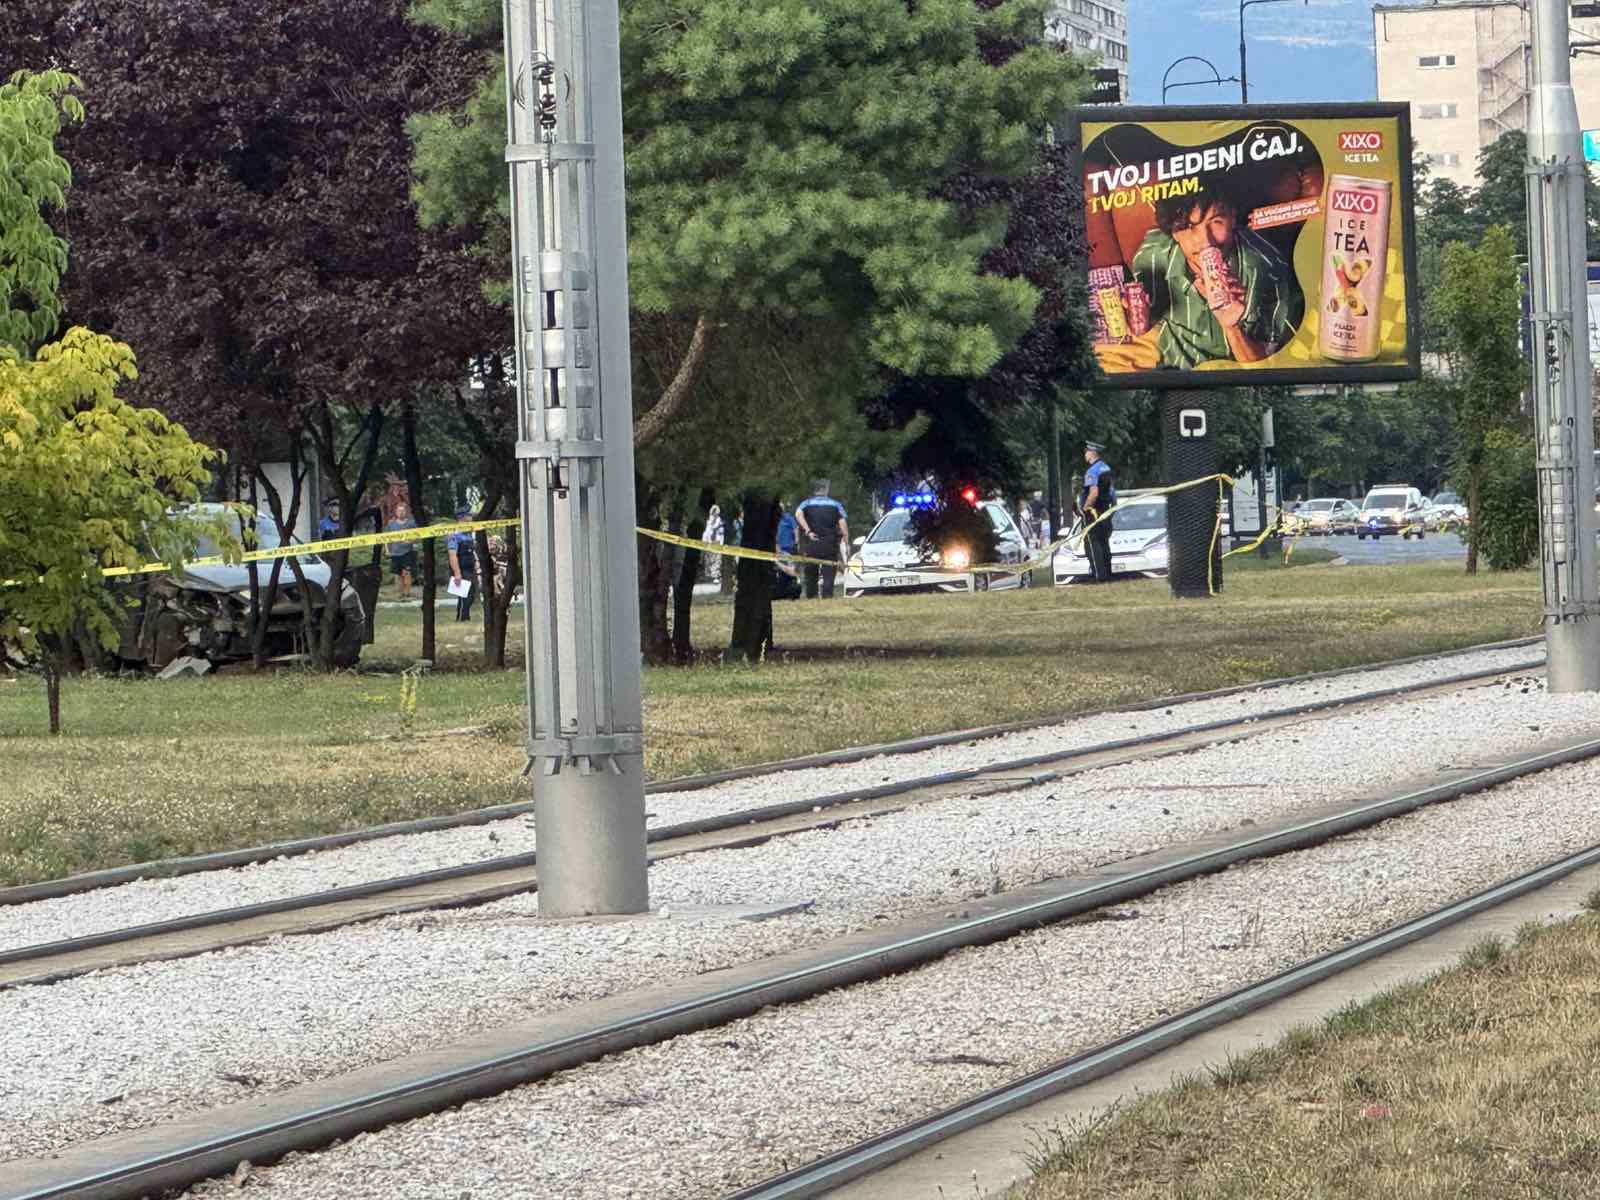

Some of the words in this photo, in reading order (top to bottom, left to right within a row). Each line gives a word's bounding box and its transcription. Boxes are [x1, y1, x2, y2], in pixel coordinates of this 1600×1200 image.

[1342, 133, 1381, 149] XIXO
[1088, 161, 1149, 194] TVOJ
[1157, 143, 1244, 180] LEDENI
[1250, 132, 1303, 161] ČAJ.
[1345, 154, 1360, 163] ICE
[1362, 153, 1379, 163] TEA
[1091, 189, 1136, 213] TVOJ
[1141, 177, 1203, 203] RITAM.
[1334, 191, 1376, 213] XIXO
[1340, 218, 1366, 230] ICE
[1334, 232, 1369, 254] TEA
